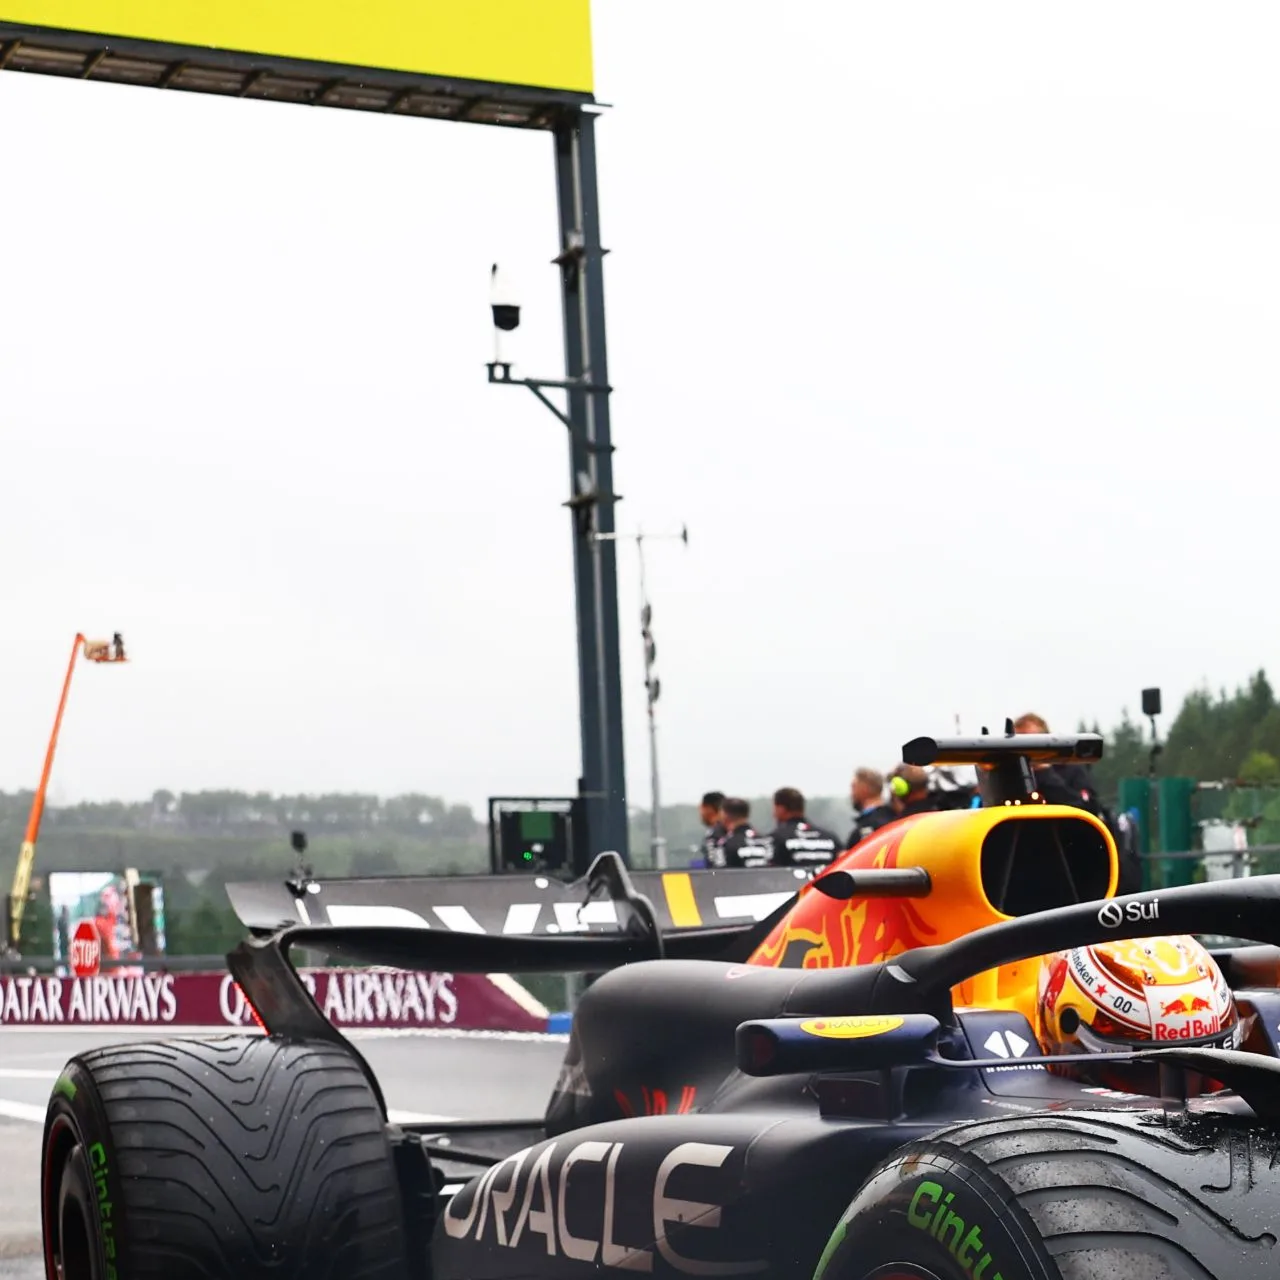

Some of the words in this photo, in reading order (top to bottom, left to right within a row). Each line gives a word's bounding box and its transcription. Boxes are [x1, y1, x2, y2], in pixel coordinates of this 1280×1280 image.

[1125, 898, 1160, 922] Sui
[71, 939, 100, 968] STOP
[0, 977, 64, 1024] ATAR
[67, 974, 177, 1023] AIRWAYS
[324, 973, 458, 1024] AIRWAYS
[1154, 1021, 1191, 1041] Red
[1193, 1015, 1222, 1038] Bull
[443, 1140, 769, 1277] ORACLE
